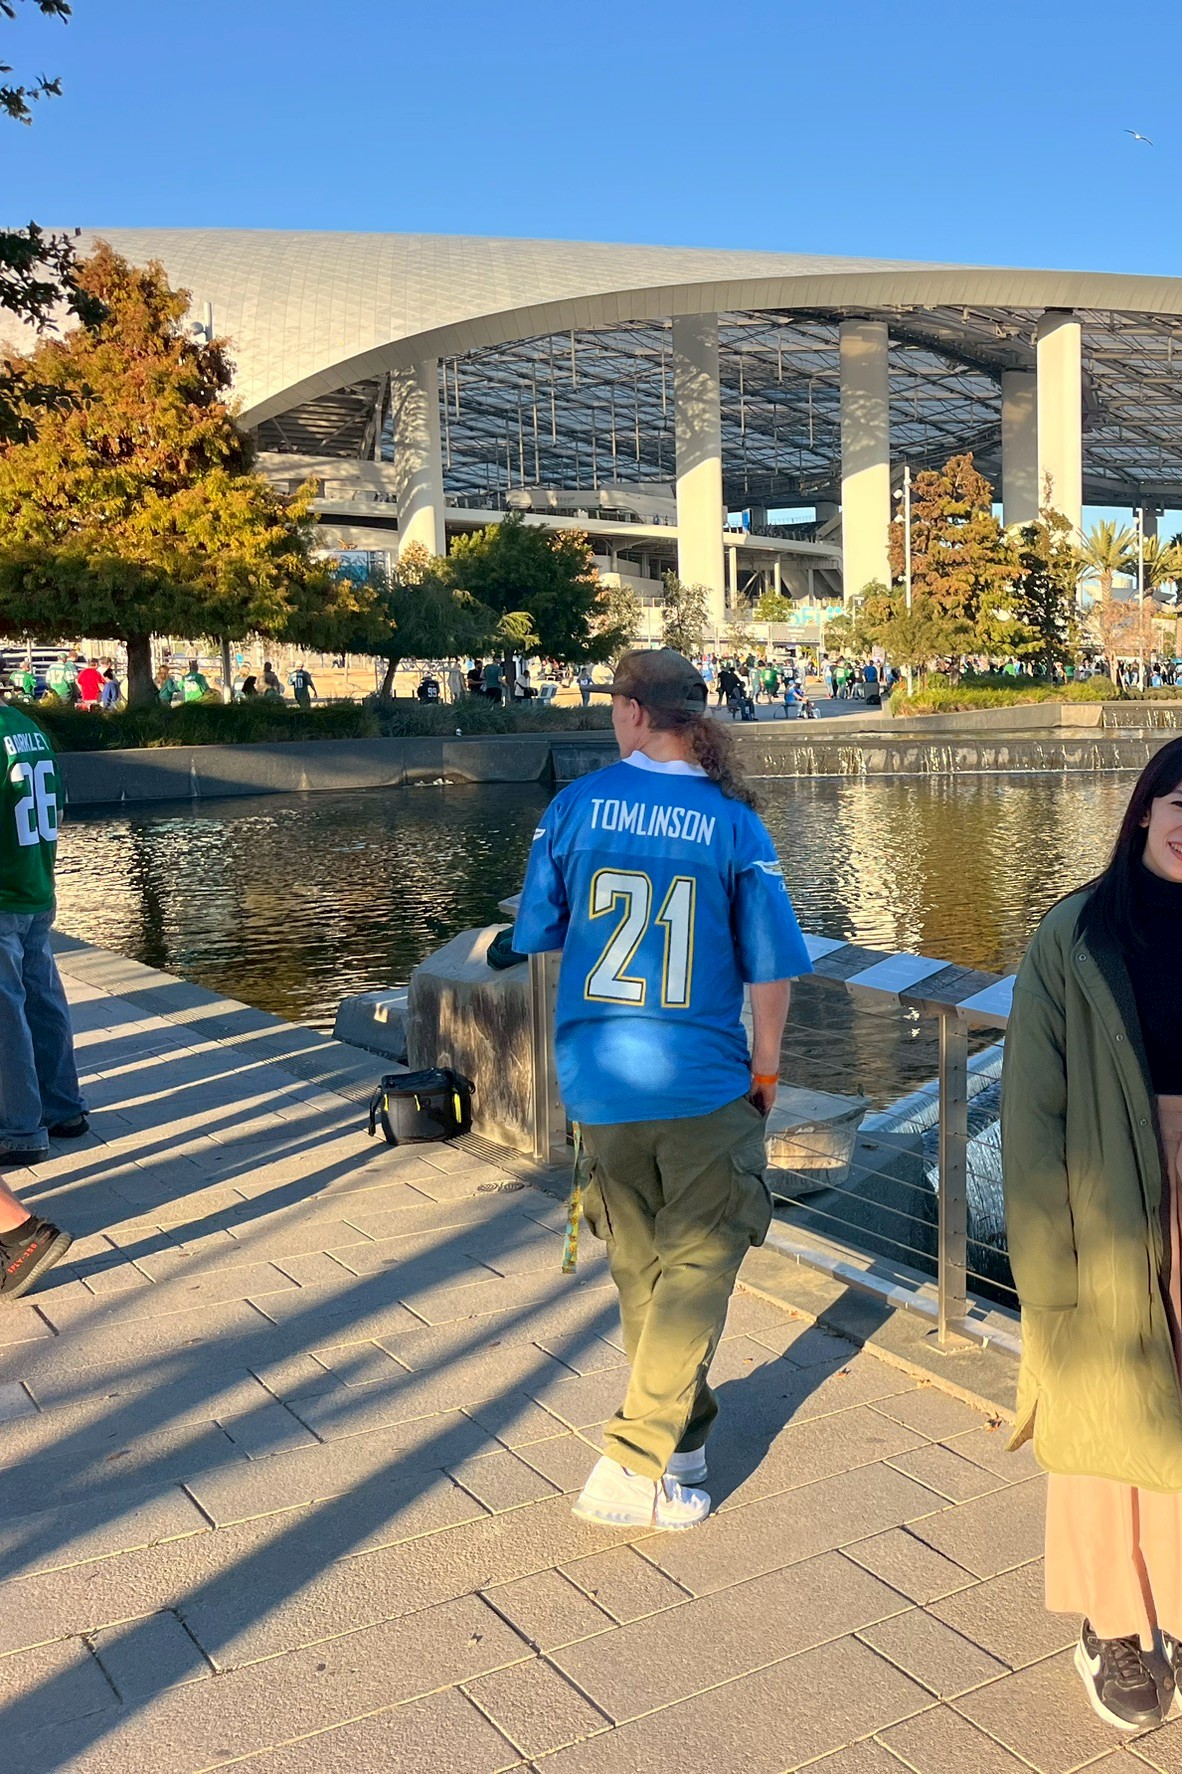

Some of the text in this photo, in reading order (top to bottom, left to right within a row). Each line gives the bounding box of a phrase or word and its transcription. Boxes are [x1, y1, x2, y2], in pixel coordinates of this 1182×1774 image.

[10, 760, 57, 846] 26
[591, 799, 716, 845] TOMLINSON
[584, 867, 696, 1009] 21
